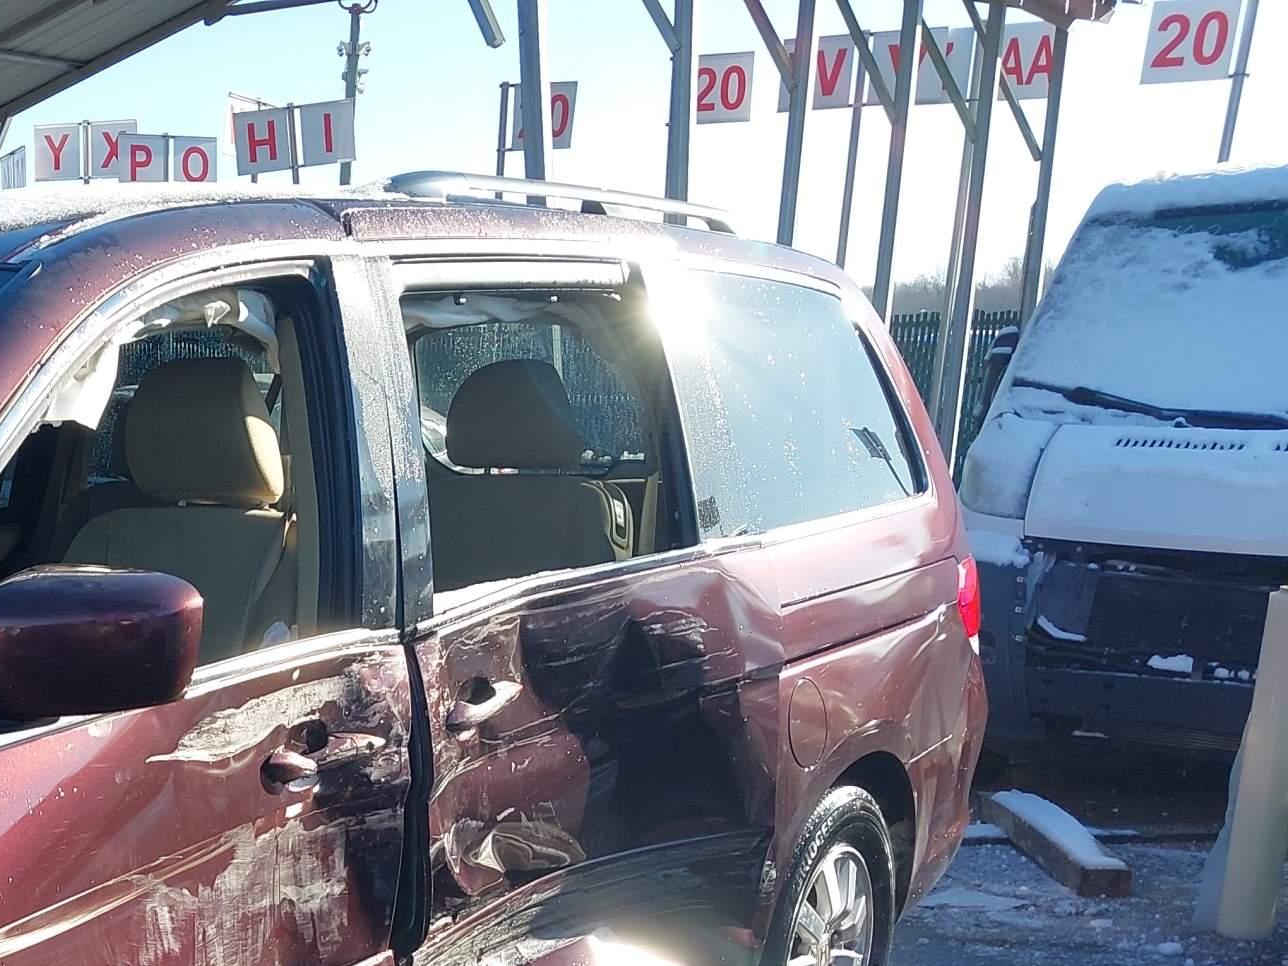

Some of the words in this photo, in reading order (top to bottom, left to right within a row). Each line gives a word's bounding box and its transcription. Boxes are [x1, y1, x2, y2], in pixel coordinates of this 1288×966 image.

[1150, 11, 1229, 68] 20
[697, 65, 746, 112] 20
[44, 133, 70, 171] Y
[247, 120, 278, 163] H
[323, 112, 334, 153] I
[130, 143, 153, 182] P
[182, 146, 209, 182] O
